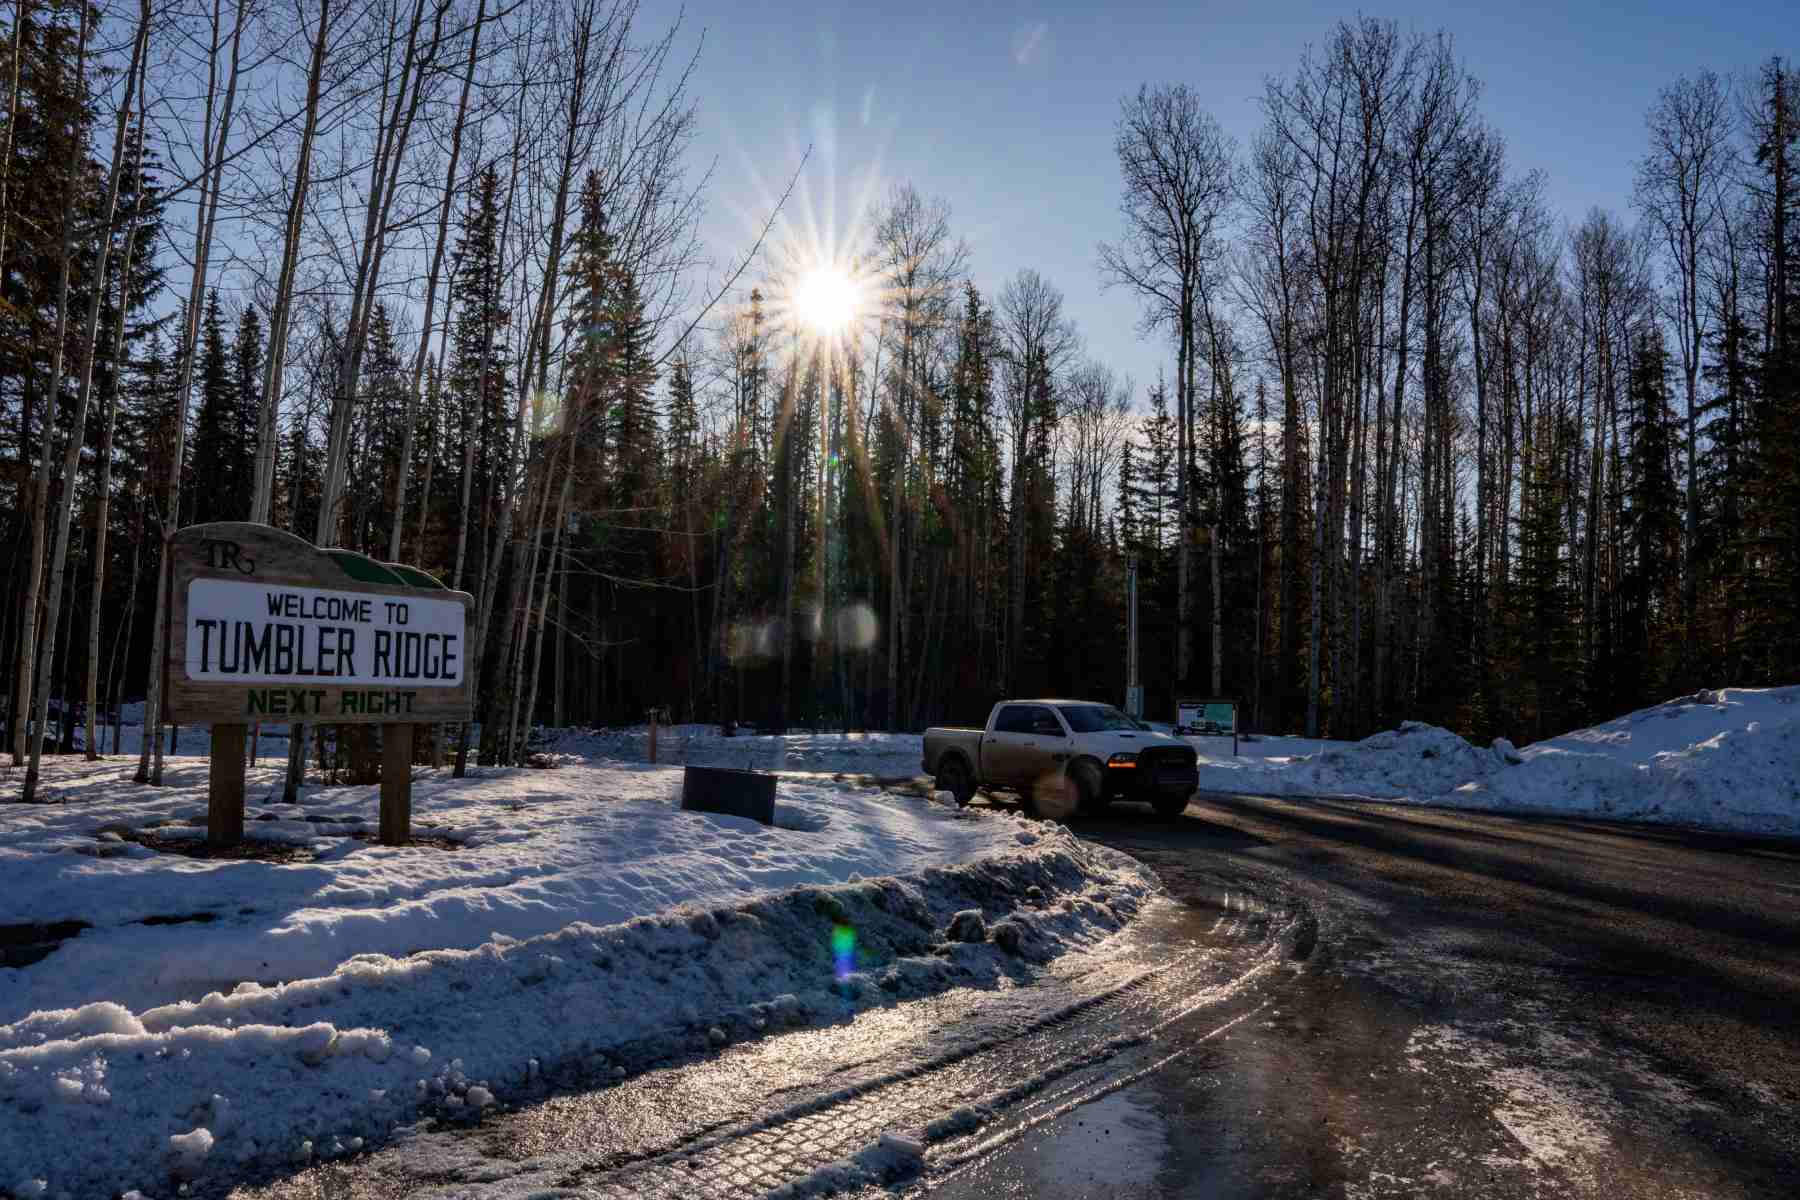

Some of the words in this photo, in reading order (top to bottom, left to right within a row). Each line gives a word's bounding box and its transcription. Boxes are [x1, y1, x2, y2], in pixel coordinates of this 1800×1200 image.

[268, 594, 372, 622] WELCOME
[385, 603, 408, 624] TO
[196, 620, 355, 676] TUMBLER
[373, 631, 457, 679] RIDGE
[248, 689, 326, 713] NEXT
[341, 690, 416, 714] RIGHT
